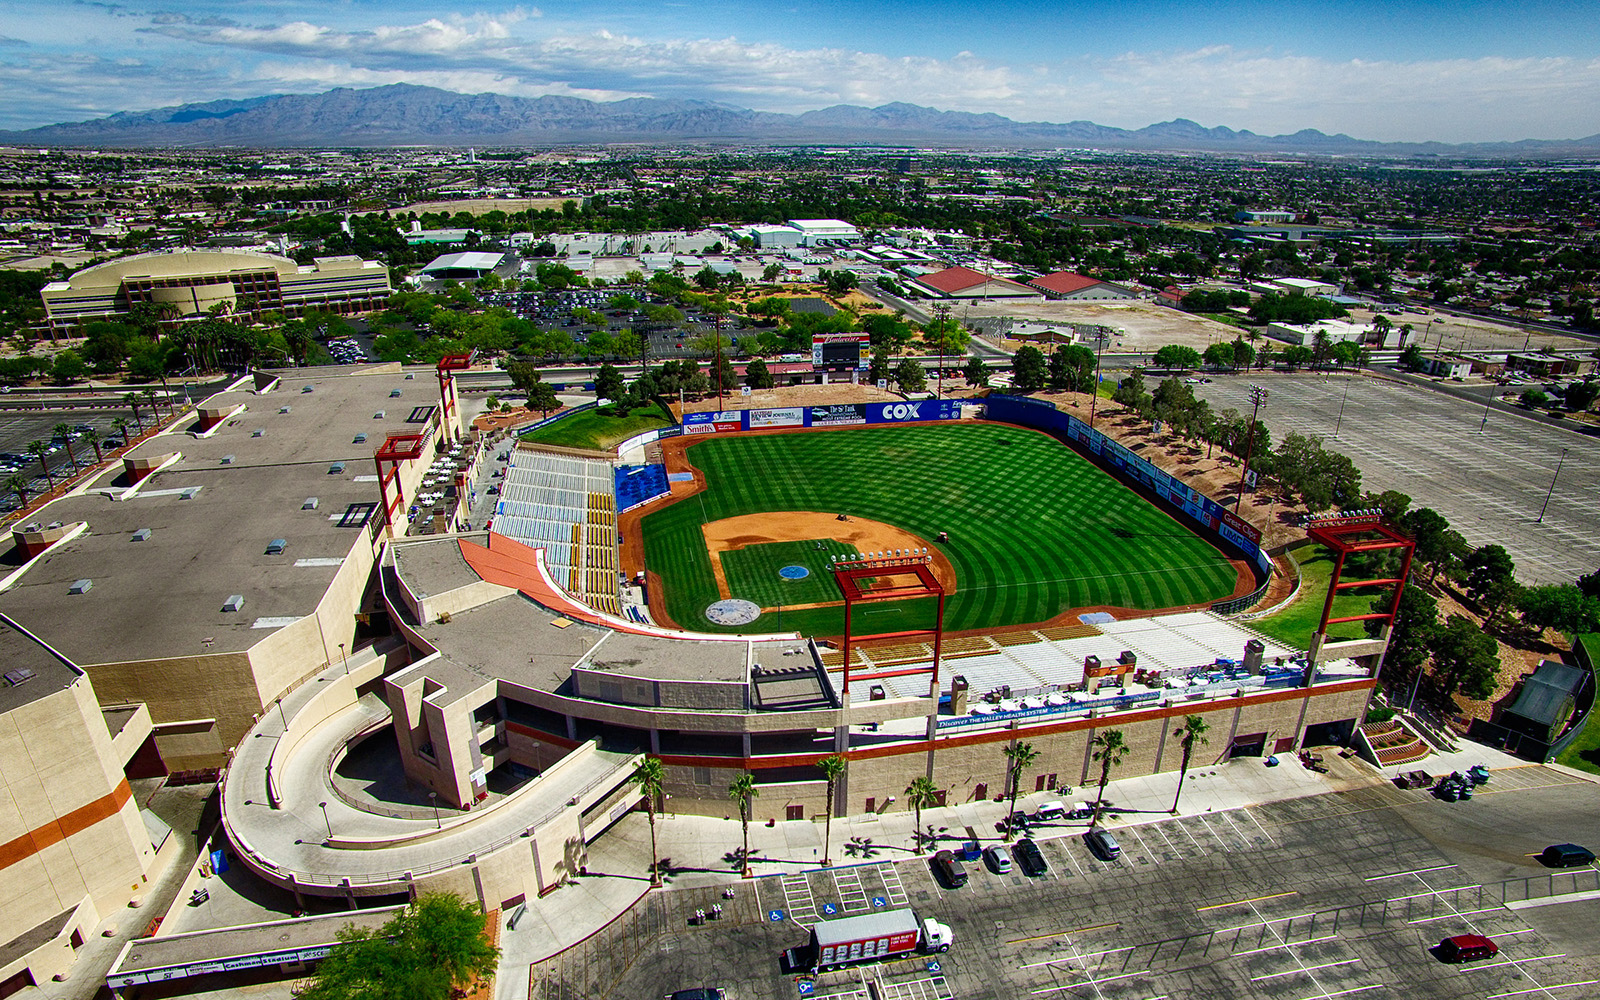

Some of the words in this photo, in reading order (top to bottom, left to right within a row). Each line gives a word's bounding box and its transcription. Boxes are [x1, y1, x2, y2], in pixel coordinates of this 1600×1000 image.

[882, 402, 923, 421] COX
[1224, 513, 1242, 530] Great
[1242, 524, 1258, 541] Clips
[939, 719, 968, 729] Discover
[1026, 709, 1048, 717] SYSTEM
[226, 960, 262, 969] Cashman
[263, 955, 298, 964] Stadium
